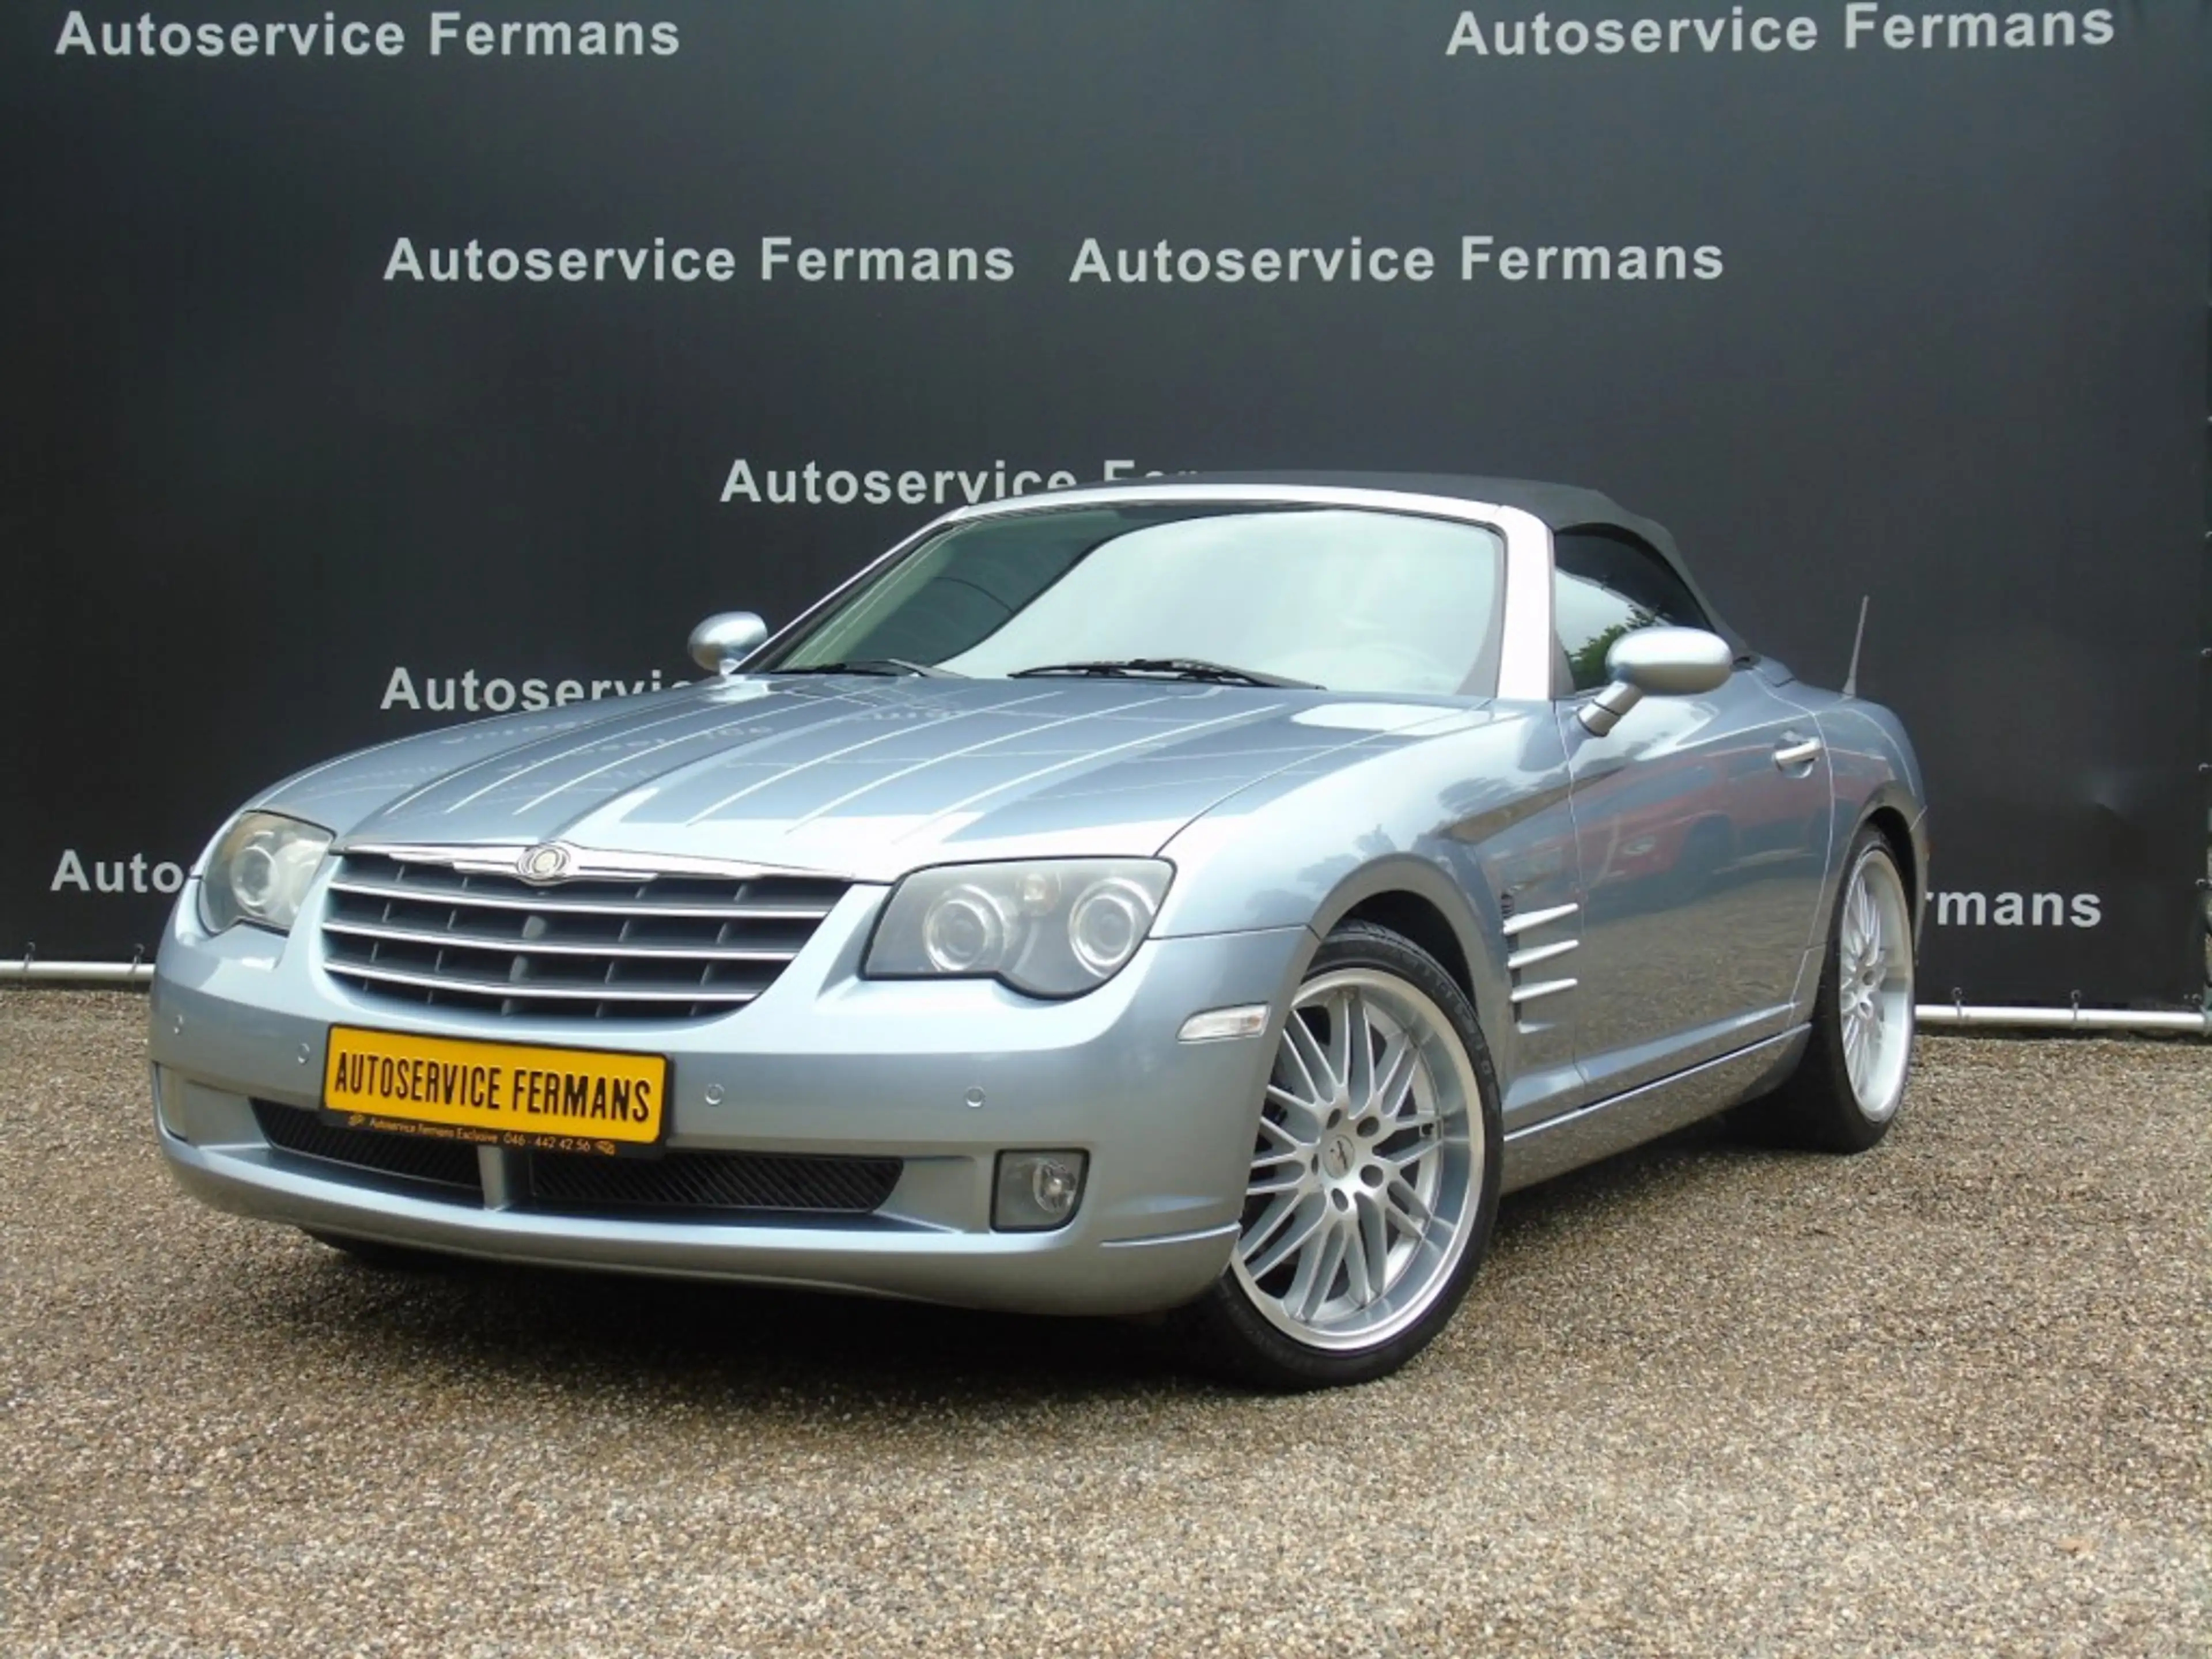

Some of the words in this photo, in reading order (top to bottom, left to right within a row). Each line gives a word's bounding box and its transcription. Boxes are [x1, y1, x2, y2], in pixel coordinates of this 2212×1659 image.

[55, 12, 405, 56] Autoservice
[430, 11, 679, 56] Fermans
[1445, 6, 1818, 56] Autoservice
[1845, 2, 2114, 50] Fermans
[383, 237, 736, 282] Autoservice
[762, 237, 1014, 282] Fermans
[1069, 236, 1434, 283] Autoservice
[1461, 236, 1723, 282] Fermans
[50, 849, 192, 893] Auto
[1926, 891, 2102, 928] mans
[334, 1052, 501, 1110] AUTOSERVICE
[512, 1070, 651, 1123] FERMANS
[503, 1132, 525, 1146] 046
[559, 1138, 574, 1150] 42
